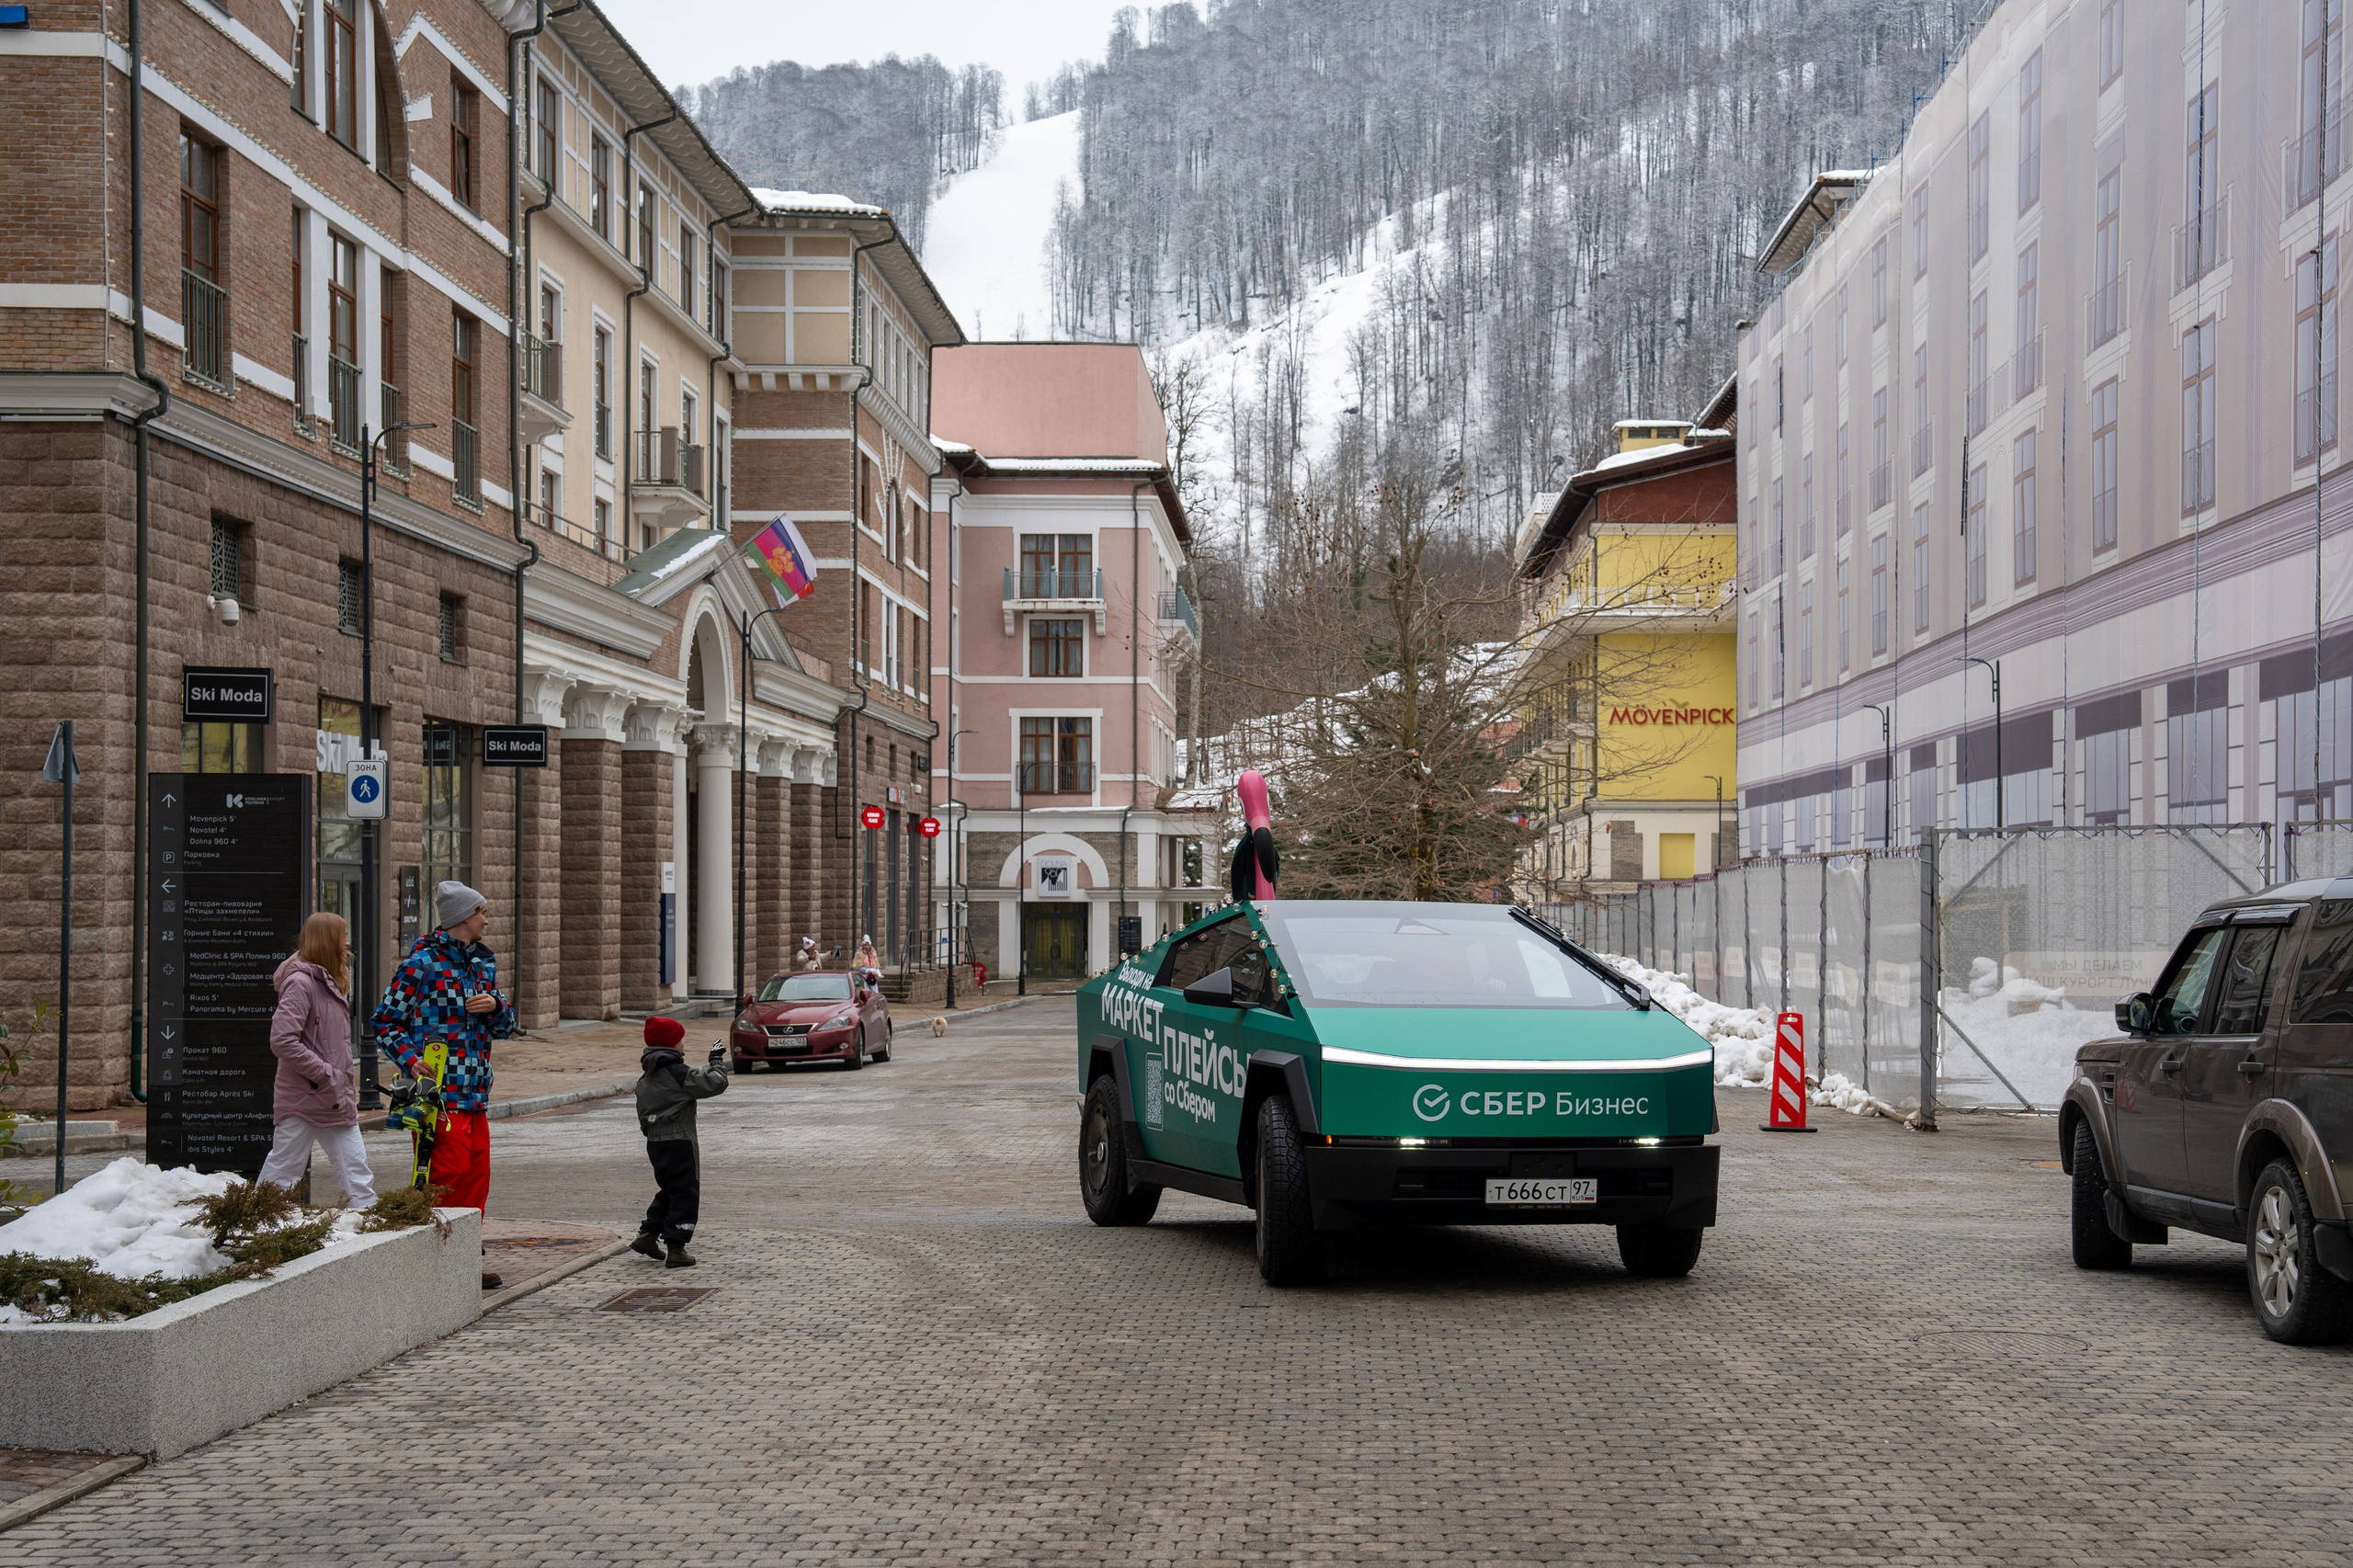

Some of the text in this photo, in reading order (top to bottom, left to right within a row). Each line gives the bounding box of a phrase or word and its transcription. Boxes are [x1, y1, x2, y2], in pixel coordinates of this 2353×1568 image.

[191, 687, 263, 702] Ski Moda
[1609, 704, 1734, 725] MÖVENPICK
[316, 729, 342, 773] Ski
[488, 741, 541, 752] Ski Moda
[355, 764, 377, 772] ЗОНА
[184, 851, 220, 859] Парковка
[184, 900, 262, 908] Ресторан-пивоварня
[184, 929, 210, 937] Горные
[2053, 960, 2143, 972] МЫ ДЕЛАЕМ
[1118, 960, 1154, 991] Выходи на
[2060, 976, 2117, 988] КУРОРТ
[227, 1006, 236, 1014] by
[1101, 983, 1165, 1045] МАРКЕТ
[1165, 1079, 1216, 1123] со Сбером
[1461, 1091, 1649, 1115] СБЕР Бизнес
[182, 1112, 222, 1120] Культурный
[202, 1145, 225, 1153] Styles
[1573, 1181, 1590, 1195] 97
